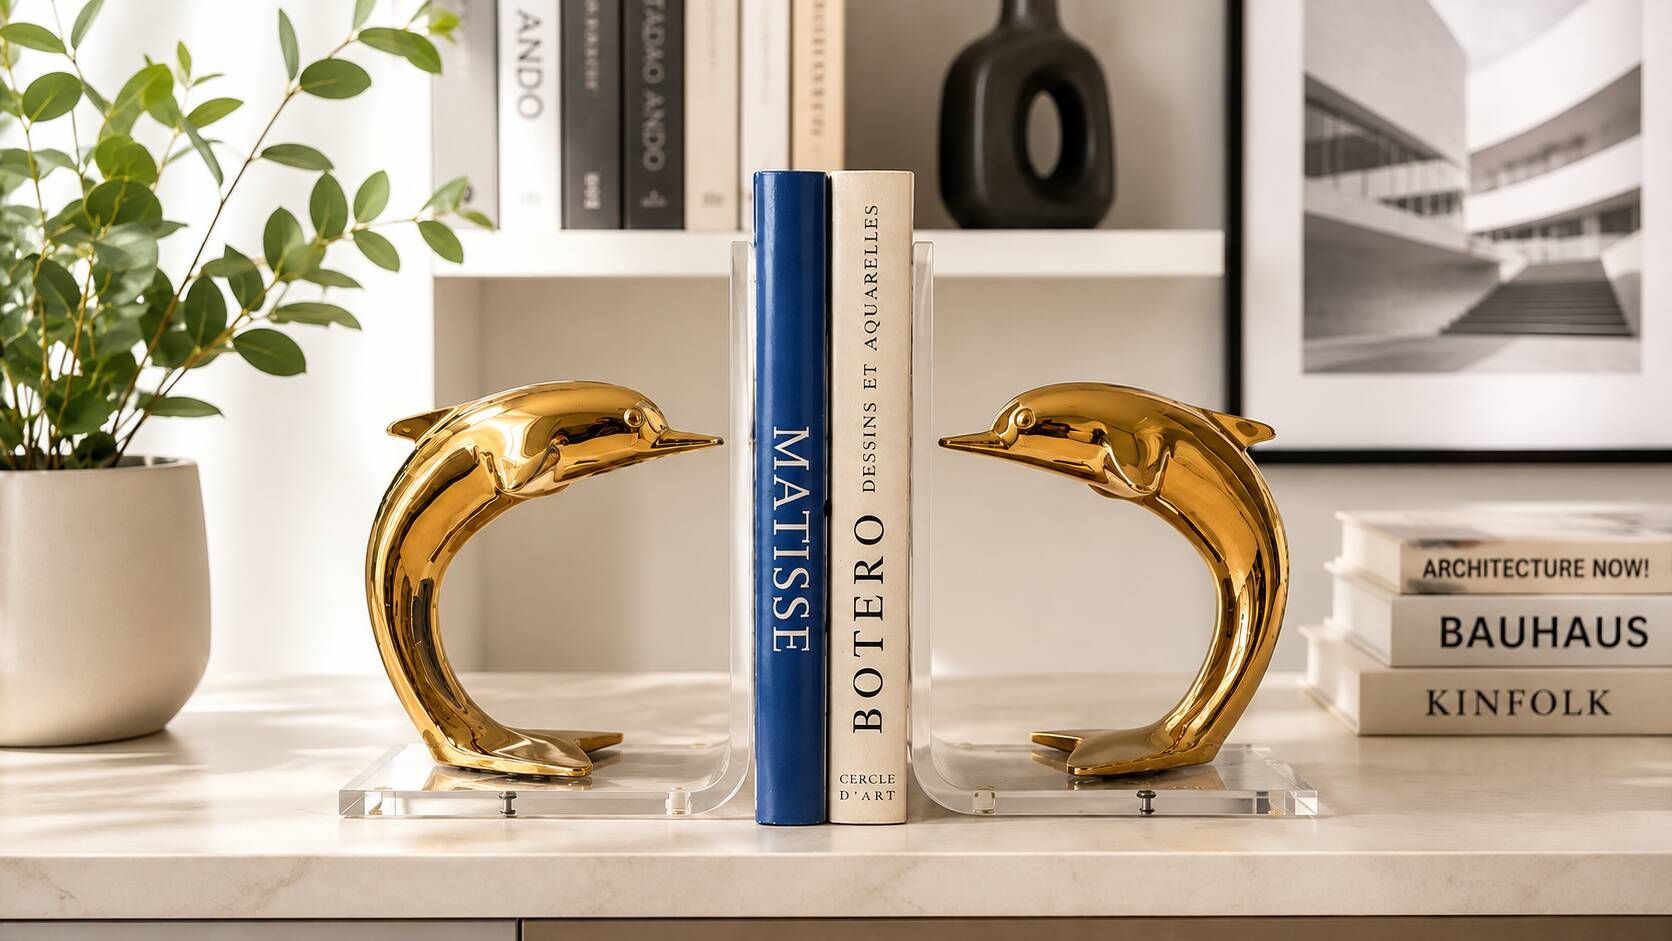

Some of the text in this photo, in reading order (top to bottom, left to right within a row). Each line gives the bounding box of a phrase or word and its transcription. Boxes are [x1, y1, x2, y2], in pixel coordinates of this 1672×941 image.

[516, 9, 544, 119] ANDO
[641, 89, 667, 172] ANDO
[852, 204, 885, 734] BOTERO DESSINS ET AQUARELLES
[772, 426, 811, 652] MATISSE
[1422, 558, 1650, 579] ARCHITECTURE NOW!
[1440, 615, 1649, 649] BAUHAUS
[1426, 689, 1612, 716] KINFOLK
[839, 773, 896, 785] CERCLE
